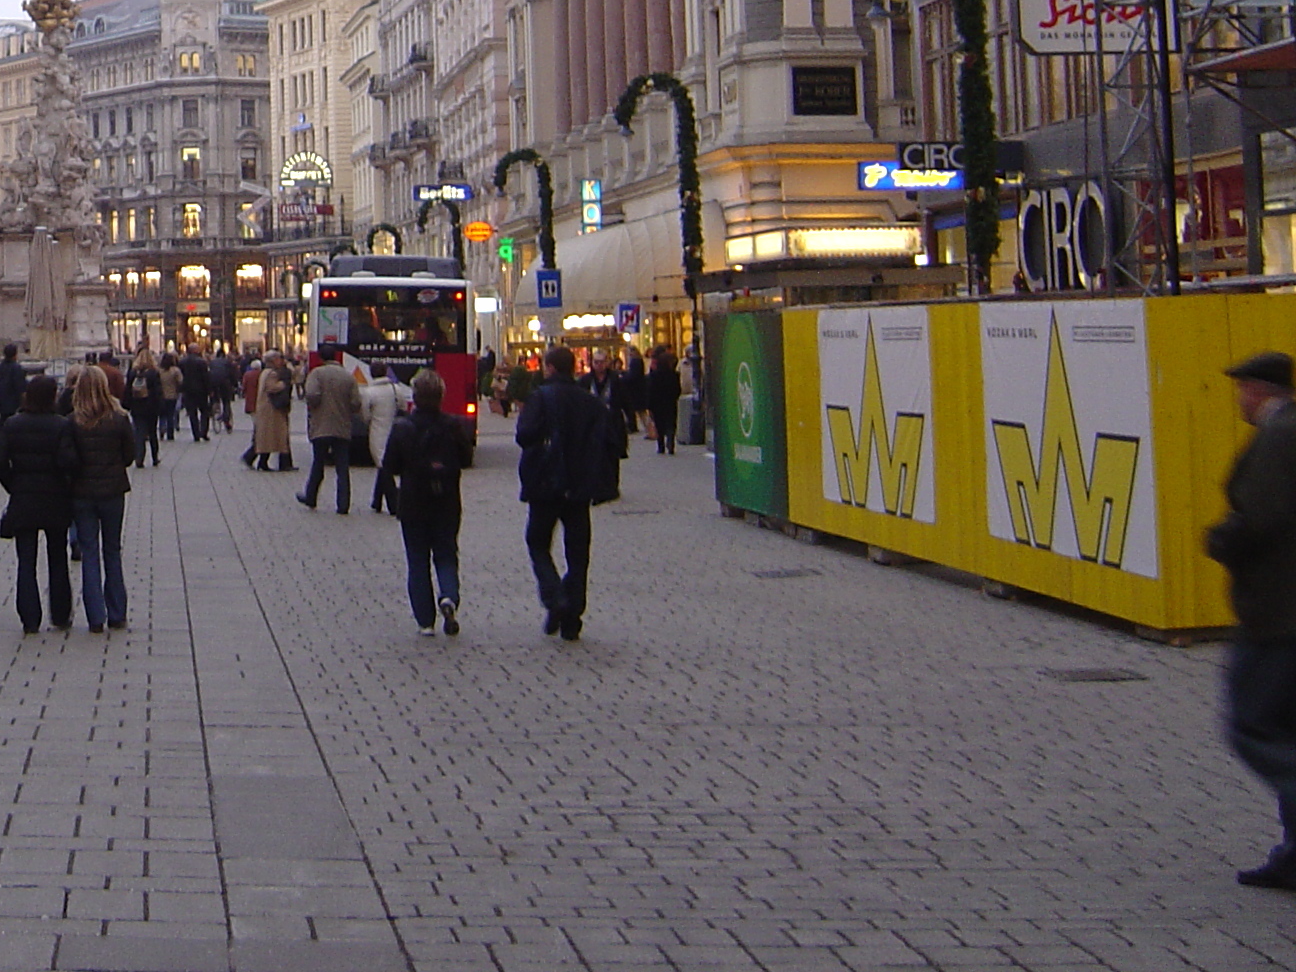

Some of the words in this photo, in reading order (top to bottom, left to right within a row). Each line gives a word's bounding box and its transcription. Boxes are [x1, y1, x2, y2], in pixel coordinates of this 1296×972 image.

[1040, 31, 1059, 40] DAS
[1064, 31, 1115, 40] MOKAIN
[1019, 180, 1105, 292] CIRO
